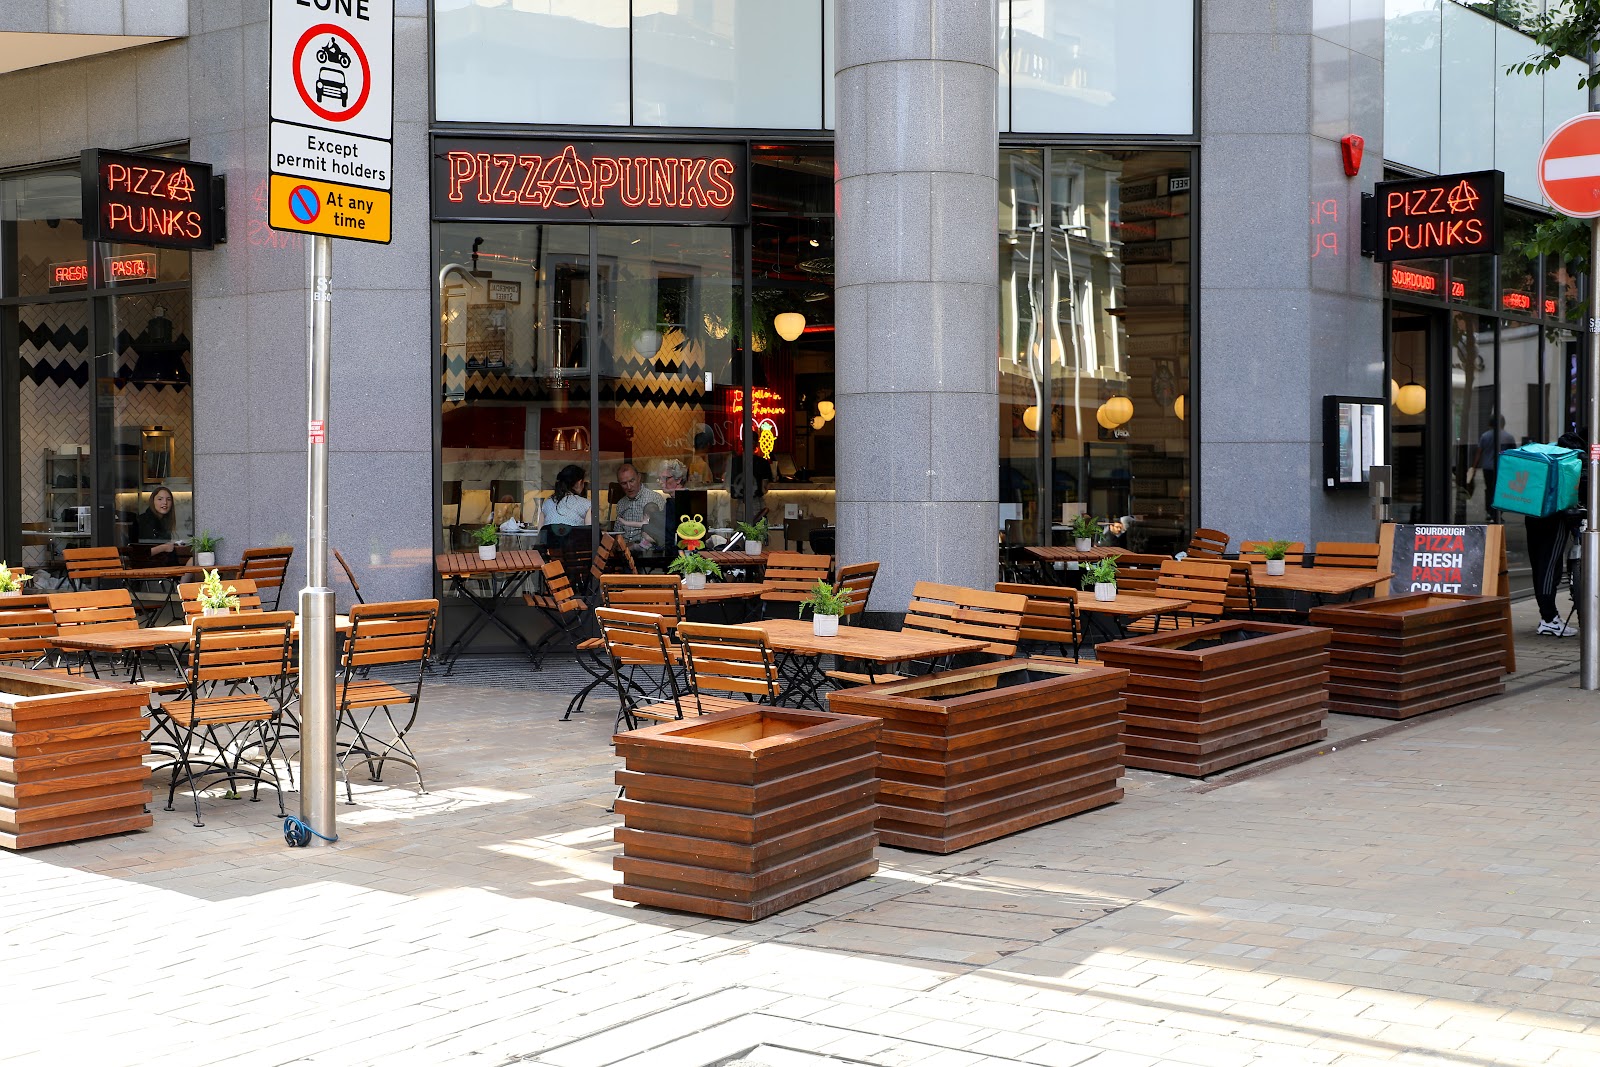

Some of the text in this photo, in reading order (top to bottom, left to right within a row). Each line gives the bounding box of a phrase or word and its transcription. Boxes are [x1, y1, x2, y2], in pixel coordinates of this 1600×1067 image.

[297, 0, 369, 21] ONE
[308, 135, 358, 158] Except
[277, 153, 386, 181] permit holders
[108, 164, 196, 203] PIZZA
[326, 191, 374, 214] At any
[1387, 180, 1479, 217] PIZZA
[109, 203, 202, 239] PUNKS
[333, 212, 366, 230] time
[1387, 219, 1483, 251] PUNKS
[111, 259, 146, 277] PASTA
[1415, 526, 1466, 536] SOURDOUGH
[1414, 535, 1465, 552] PIZZA
[1413, 552, 1463, 568] FRESH
[1411, 566, 1463, 582] PASTA
